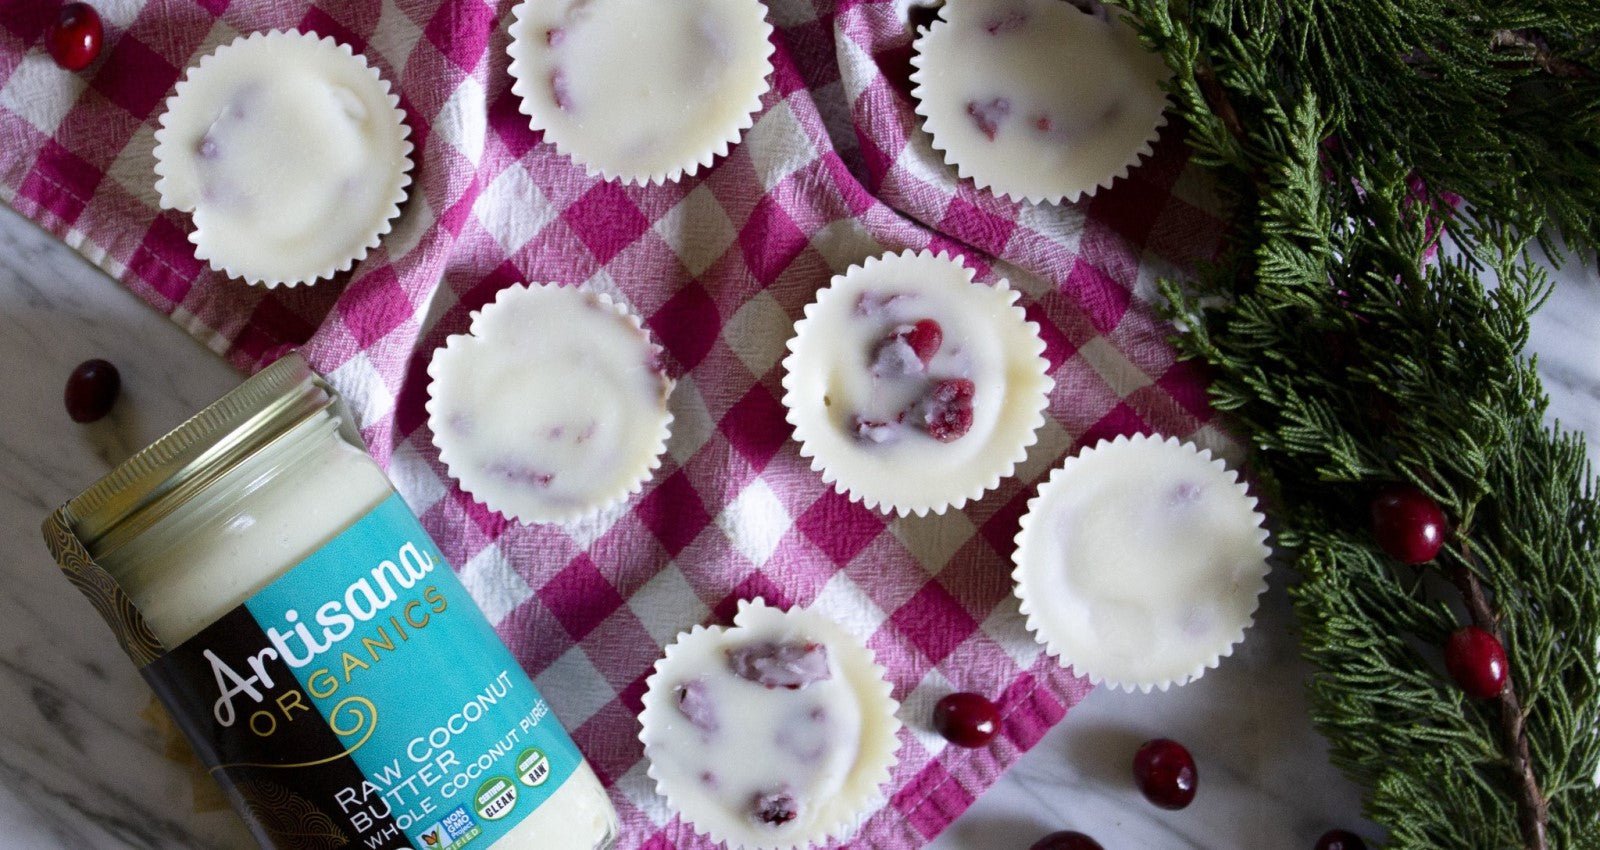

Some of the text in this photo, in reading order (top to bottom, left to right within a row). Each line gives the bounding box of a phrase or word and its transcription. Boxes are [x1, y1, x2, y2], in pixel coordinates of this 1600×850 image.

[203, 541, 434, 727] Artisana
[250, 586, 447, 737] ORGANICS
[334, 670, 513, 814] RAW COCONUT
[528, 764, 547, 783] RAW
[350, 750, 460, 833] BUTTER
[364, 796, 438, 850] WHOLE
[440, 729, 520, 799] COCONUT
[442, 807, 465, 827] NON
[447, 814, 470, 833] GMO
[485, 791, 515, 818] CLEAN
